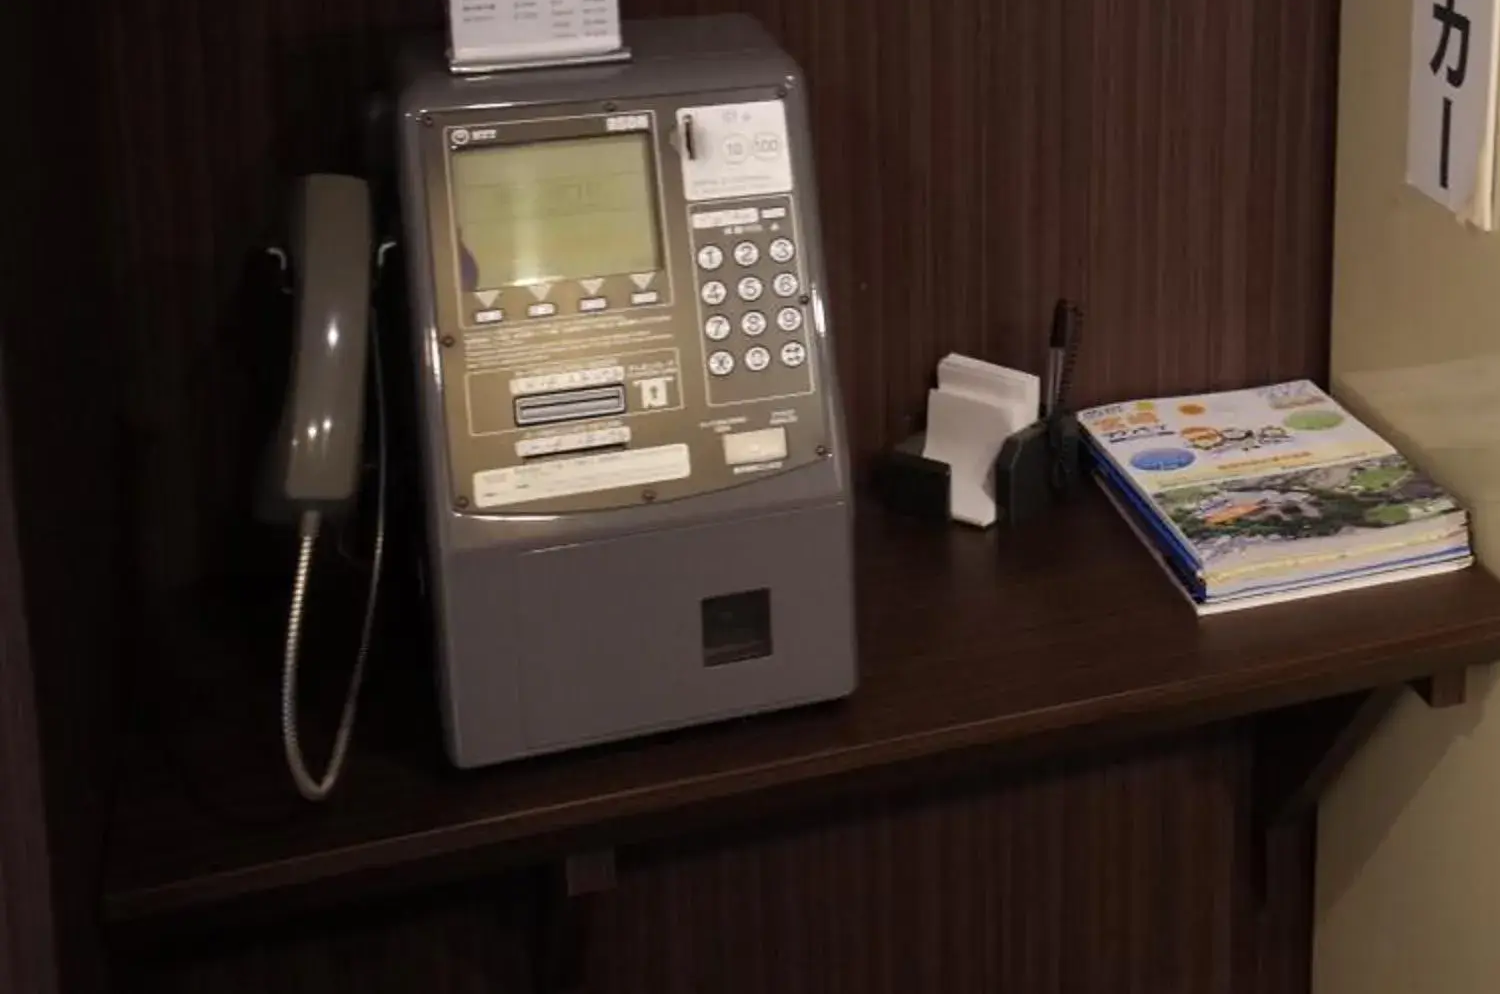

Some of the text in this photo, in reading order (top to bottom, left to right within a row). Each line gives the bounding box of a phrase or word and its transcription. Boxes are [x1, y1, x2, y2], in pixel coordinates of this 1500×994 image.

[741, 245, 753, 262] 2
[776, 242, 788, 259] 3
[707, 276, 792, 301] 4 5 6
[711, 319, 724, 336] 7
[784, 310, 796, 327] 9
